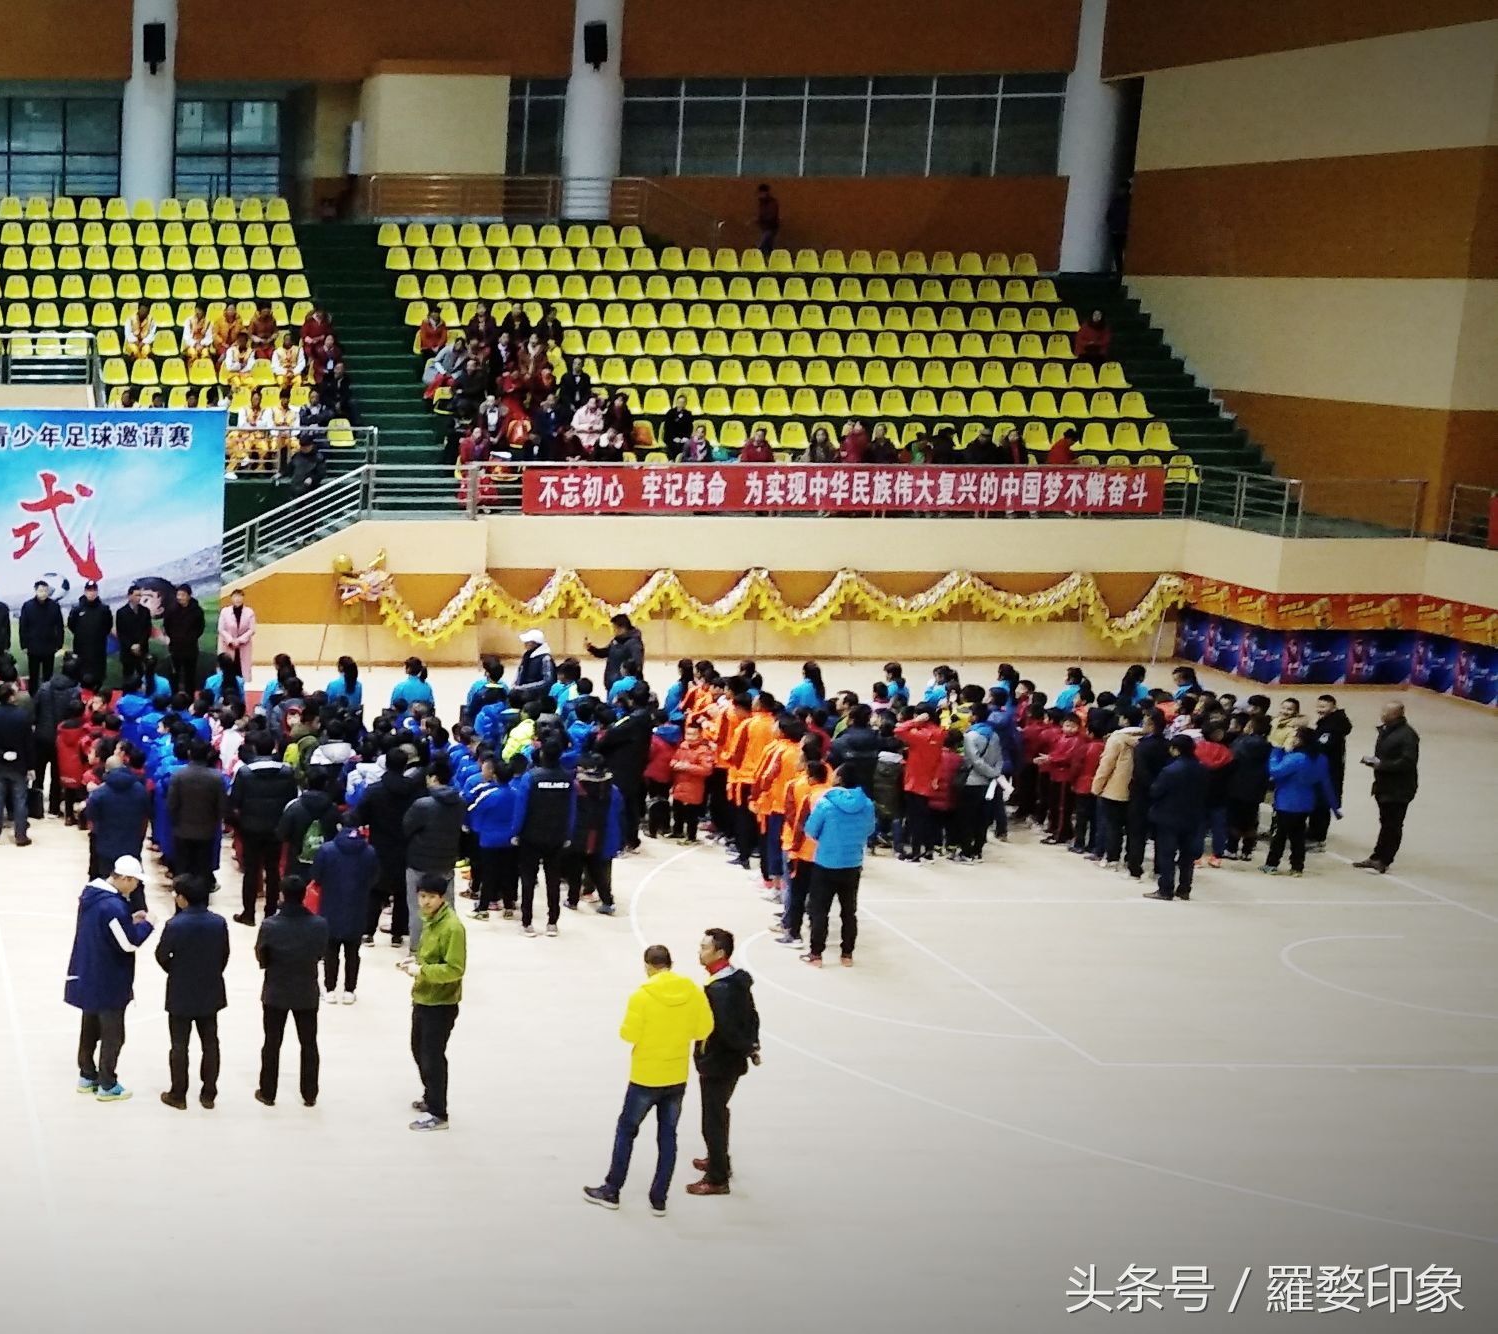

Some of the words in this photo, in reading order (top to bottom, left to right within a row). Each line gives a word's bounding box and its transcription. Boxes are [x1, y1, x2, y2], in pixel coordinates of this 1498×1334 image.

[538, 473, 625, 508] 不忘初心
[642, 471, 727, 507] 牢记使命
[743, 470, 1149, 508] 为实现中华民族伟大复兴的中国梦不懈奋斗
